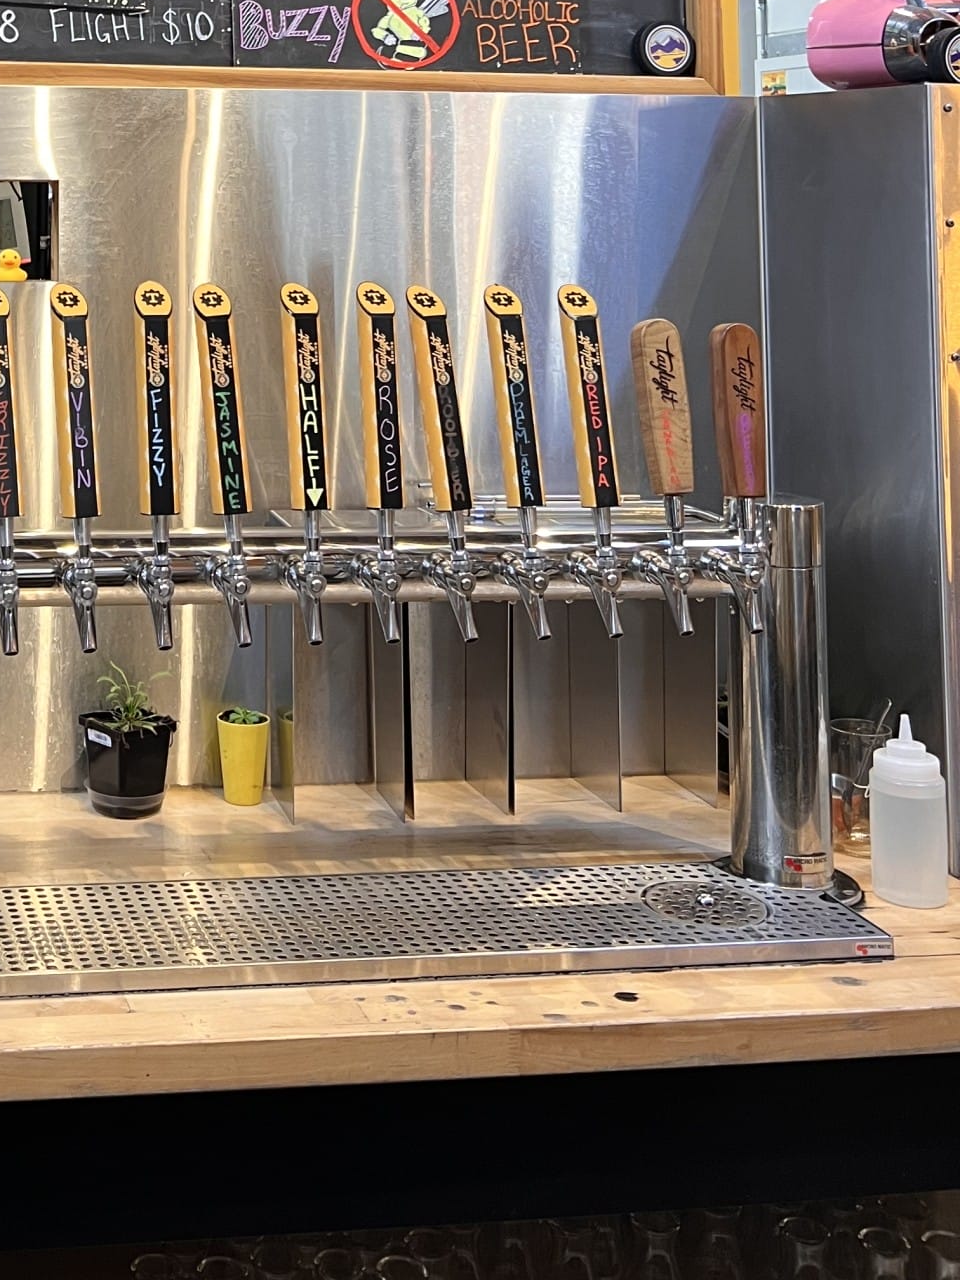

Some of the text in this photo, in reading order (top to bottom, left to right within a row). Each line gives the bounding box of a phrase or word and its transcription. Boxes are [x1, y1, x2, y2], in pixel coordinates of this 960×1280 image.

[50, 7, 215, 46] FLIGHT $10
[476, 23, 576, 64] BEER
[71, 392, 91, 488] VIBIN
[150, 389, 165, 486] FIZZY
[216, 392, 240, 509] JASMINE
[300, 384, 320, 477] HALF
[379, 385, 399, 492] ROSE
[586, 384, 609, 487] RED IPA
